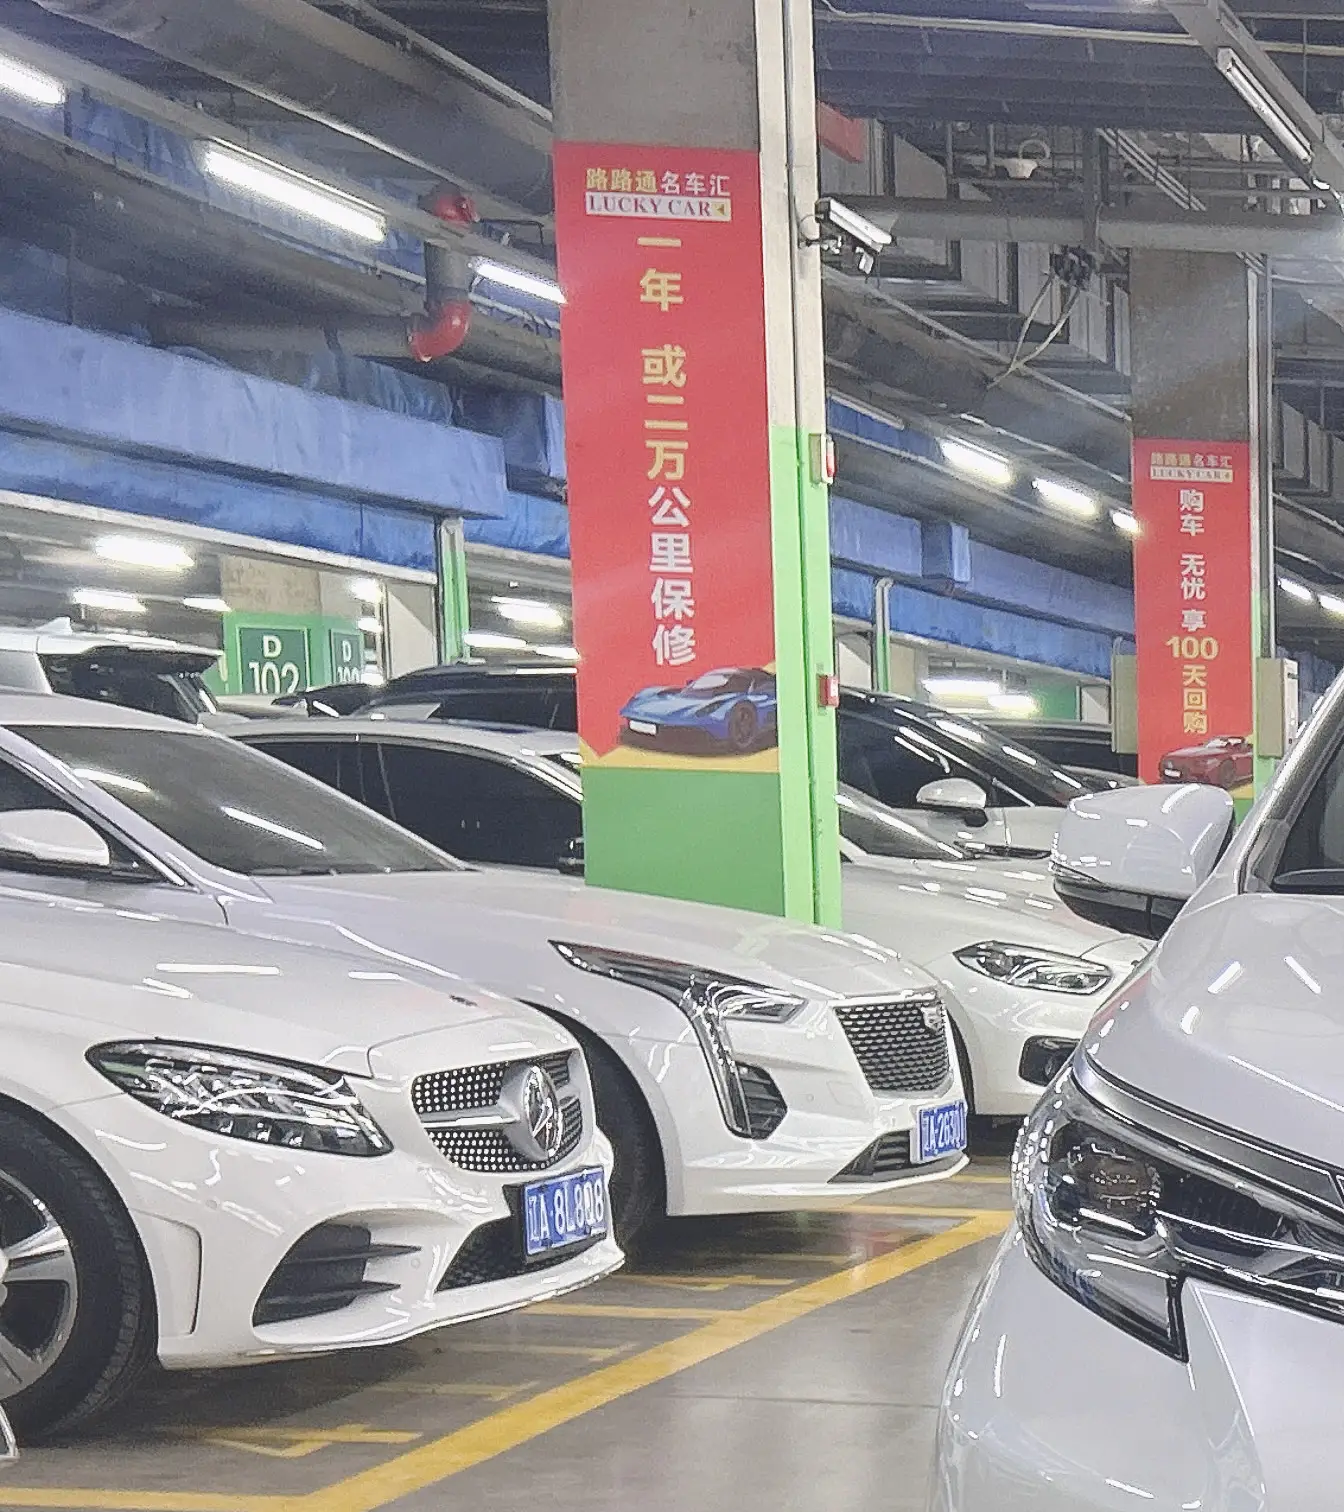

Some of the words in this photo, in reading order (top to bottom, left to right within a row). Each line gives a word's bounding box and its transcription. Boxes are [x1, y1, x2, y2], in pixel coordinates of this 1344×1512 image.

[586, 167, 731, 197] 路路通名车汇
[589, 194, 662, 214] LUCKY
[667, 198, 712, 217] CAR
[263, 635, 281, 658] D
